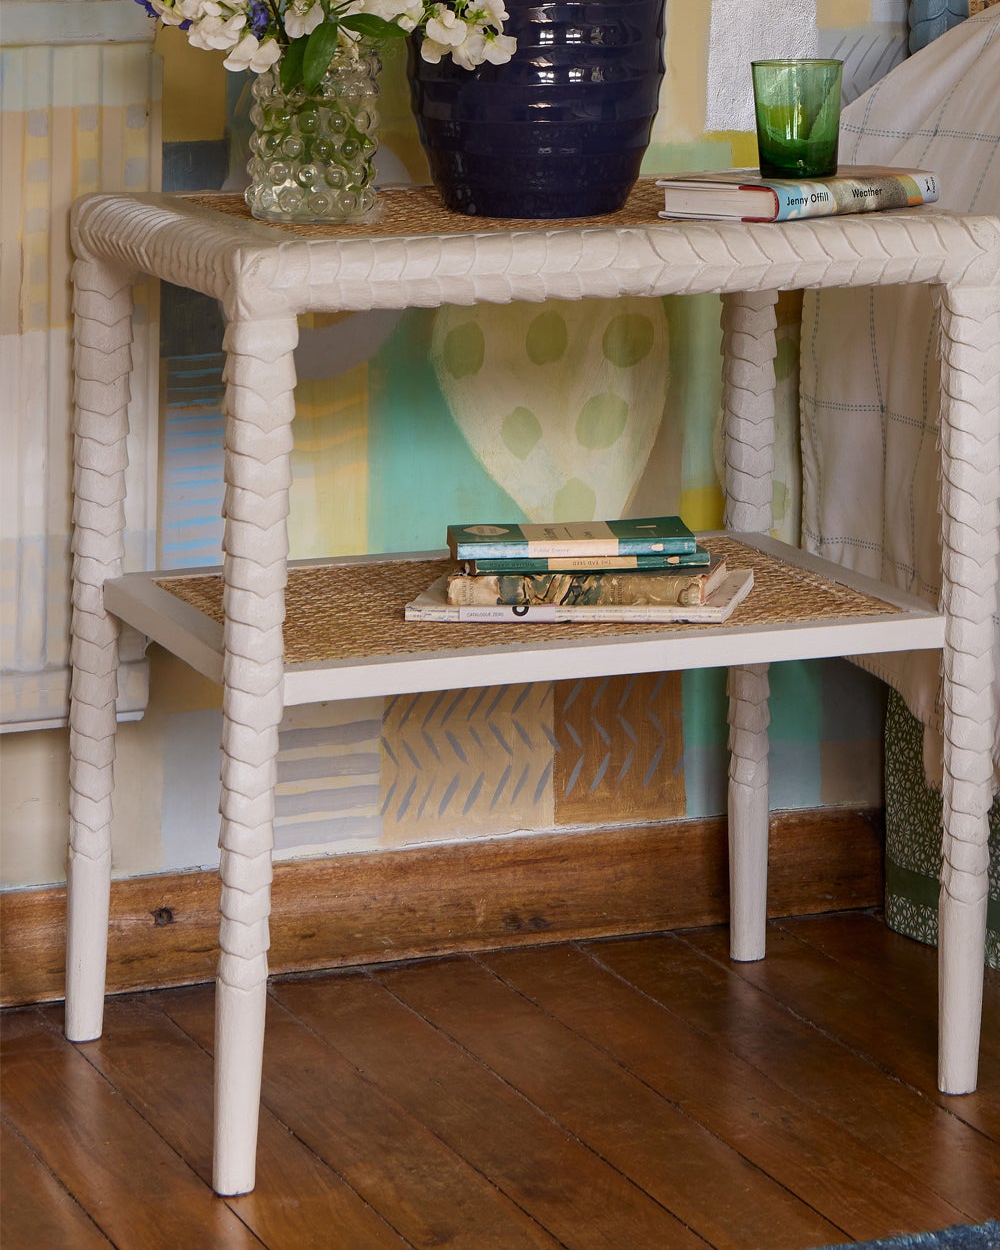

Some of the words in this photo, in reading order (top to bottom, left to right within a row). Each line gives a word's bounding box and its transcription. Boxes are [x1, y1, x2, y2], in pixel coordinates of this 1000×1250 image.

[786, 196, 809, 207] Jenny
[810, 192, 829, 203] Offill
[851, 187, 883, 199] Weather
